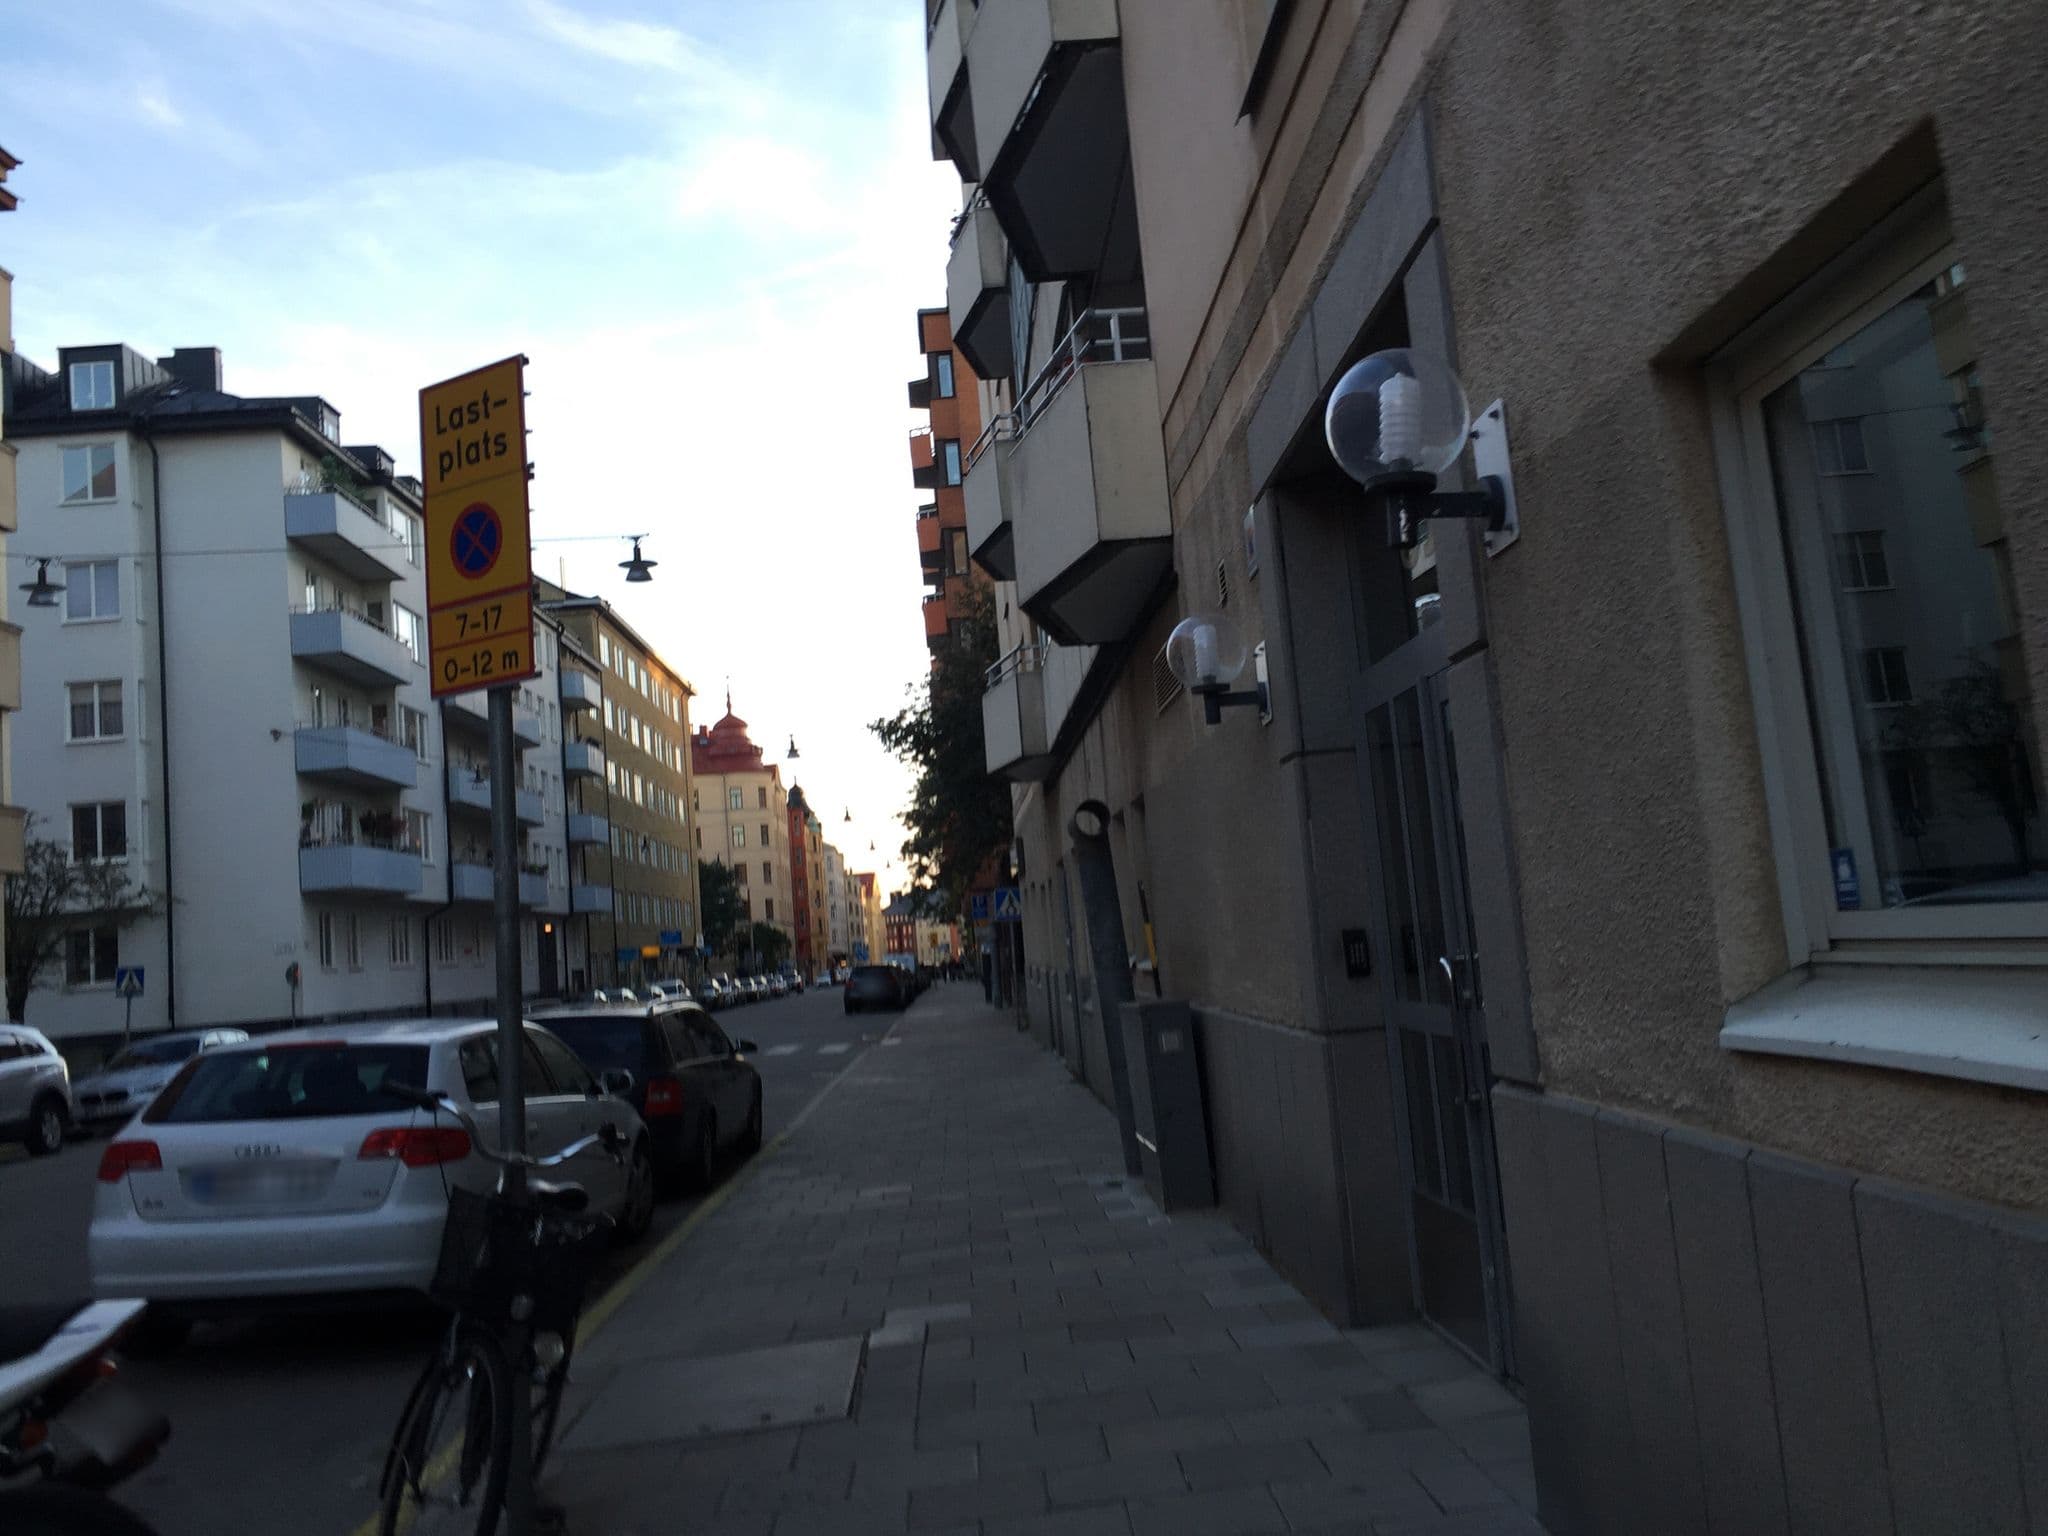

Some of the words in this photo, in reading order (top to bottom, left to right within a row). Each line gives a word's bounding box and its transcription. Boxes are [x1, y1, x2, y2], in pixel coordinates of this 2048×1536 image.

[436, 388, 508, 435] Last-
[439, 430, 508, 482] plats
[456, 604, 502, 638] 7-17
[444, 649, 493, 683] 0-12
[502, 650, 519, 671] m
